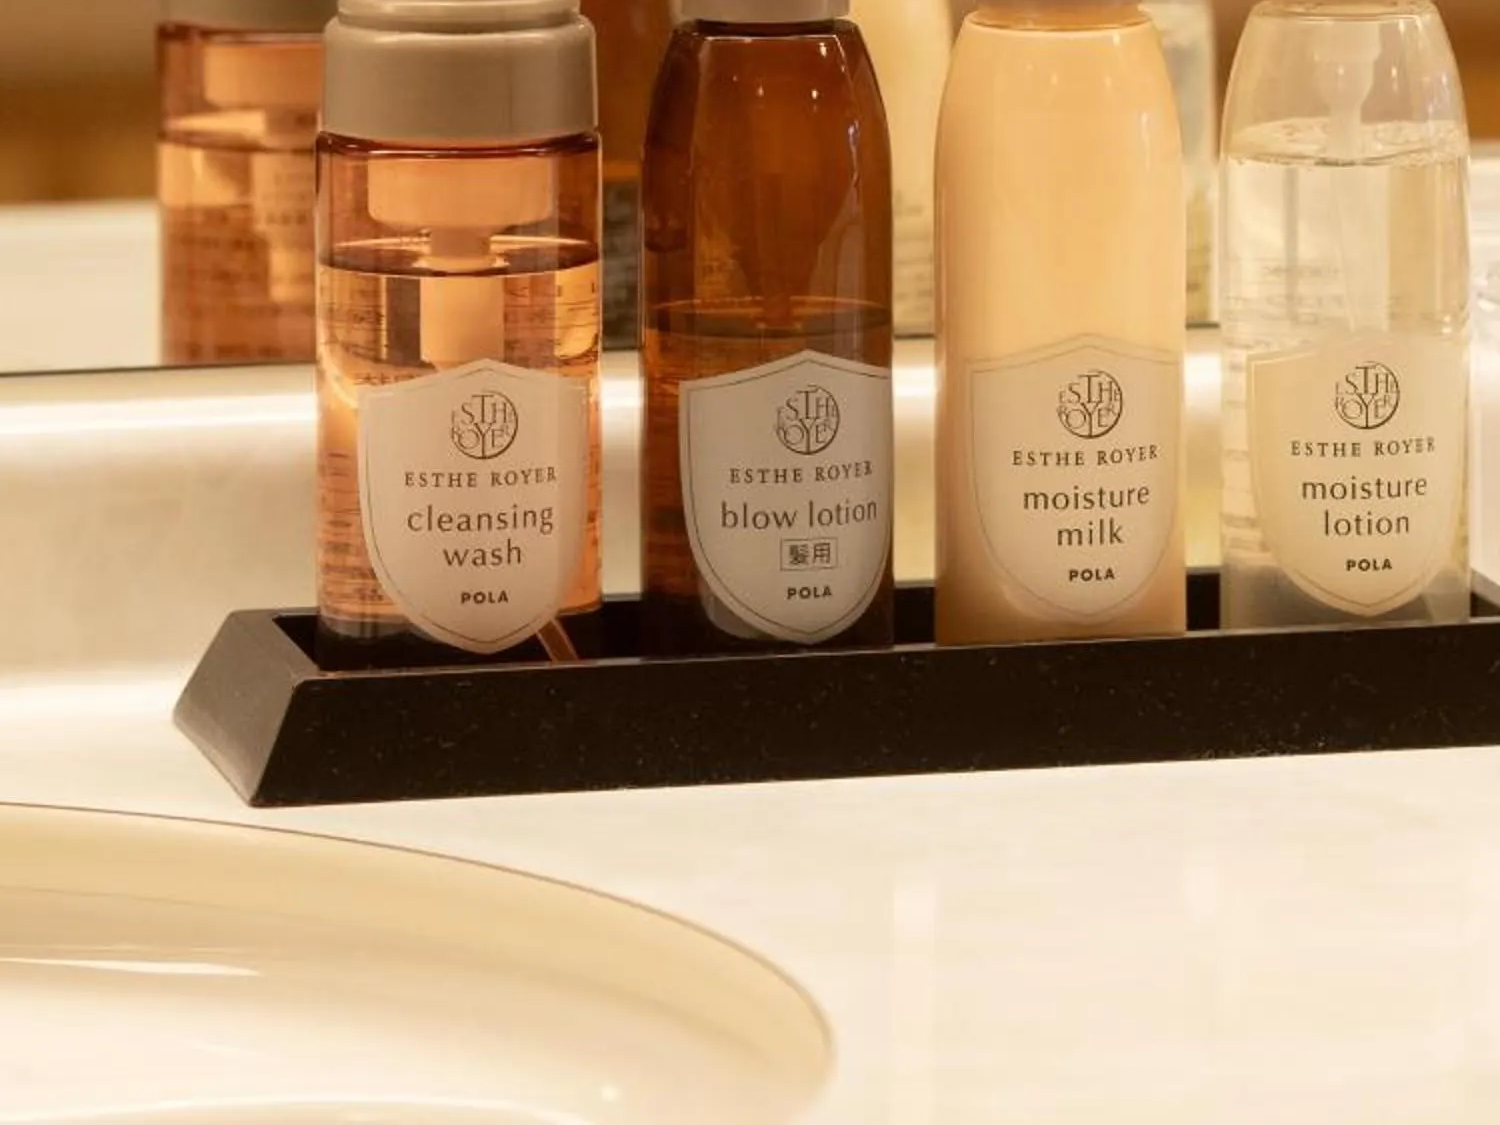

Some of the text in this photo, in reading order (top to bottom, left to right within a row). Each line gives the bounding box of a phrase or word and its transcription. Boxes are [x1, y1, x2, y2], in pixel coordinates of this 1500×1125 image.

[1012, 444, 1158, 467] ESTHE ROYER
[1290, 436, 1436, 458] ESTHE ROYER
[404, 466, 557, 488] ESTHE ROYER
[730, 460, 873, 484] ESTHE ROYER
[1023, 485, 1150, 510] moisture
[1301, 475, 1428, 501] moisture
[407, 504, 554, 535] cleansing
[721, 498, 877, 530] blow lotion
[1324, 509, 1410, 537] lotion
[1057, 517, 1125, 546] milk
[442, 538, 521, 567] wash
[789, 542, 831, 566] 髪用
[1069, 567, 1116, 581] POLA
[1345, 558, 1393, 572] POLA
[460, 591, 509, 604] POLA
[787, 586, 832, 600] POLA
